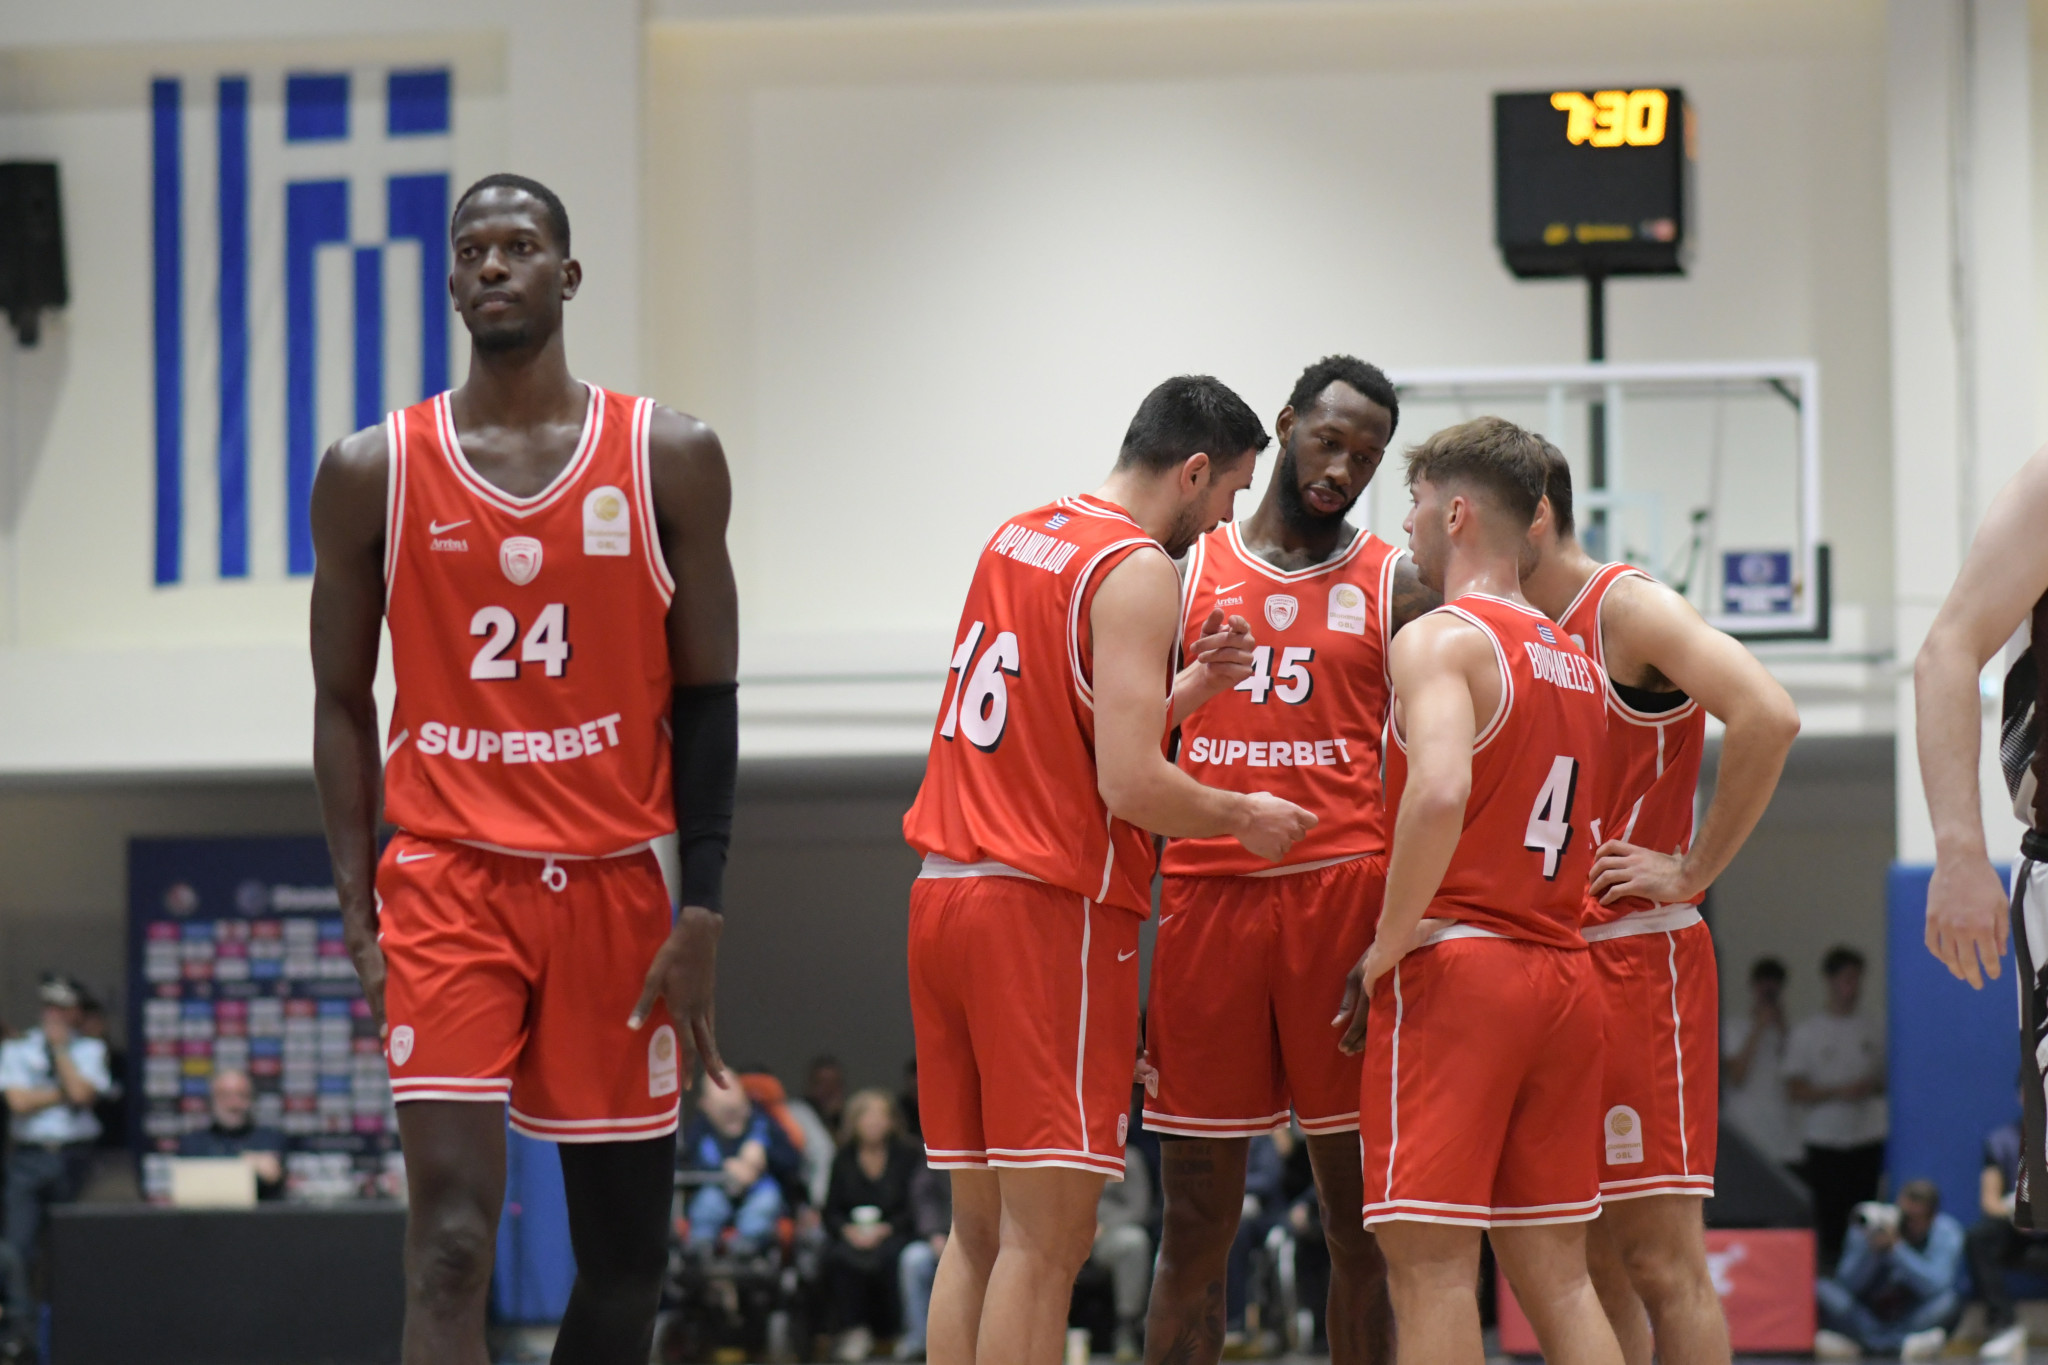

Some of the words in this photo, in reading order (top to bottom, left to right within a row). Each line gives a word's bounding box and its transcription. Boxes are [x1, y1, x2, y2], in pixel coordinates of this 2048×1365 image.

[1550, 88, 1669, 147] 7:30
[989, 523, 1080, 575] PAPANIKOLAOU
[469, 603, 572, 681] 24
[939, 620, 1021, 754] 16
[1233, 645, 1316, 706] 45
[416, 712, 622, 764] SUPERBET
[1188, 736, 1352, 768] SUPERBET
[1523, 755, 1580, 882] 4
